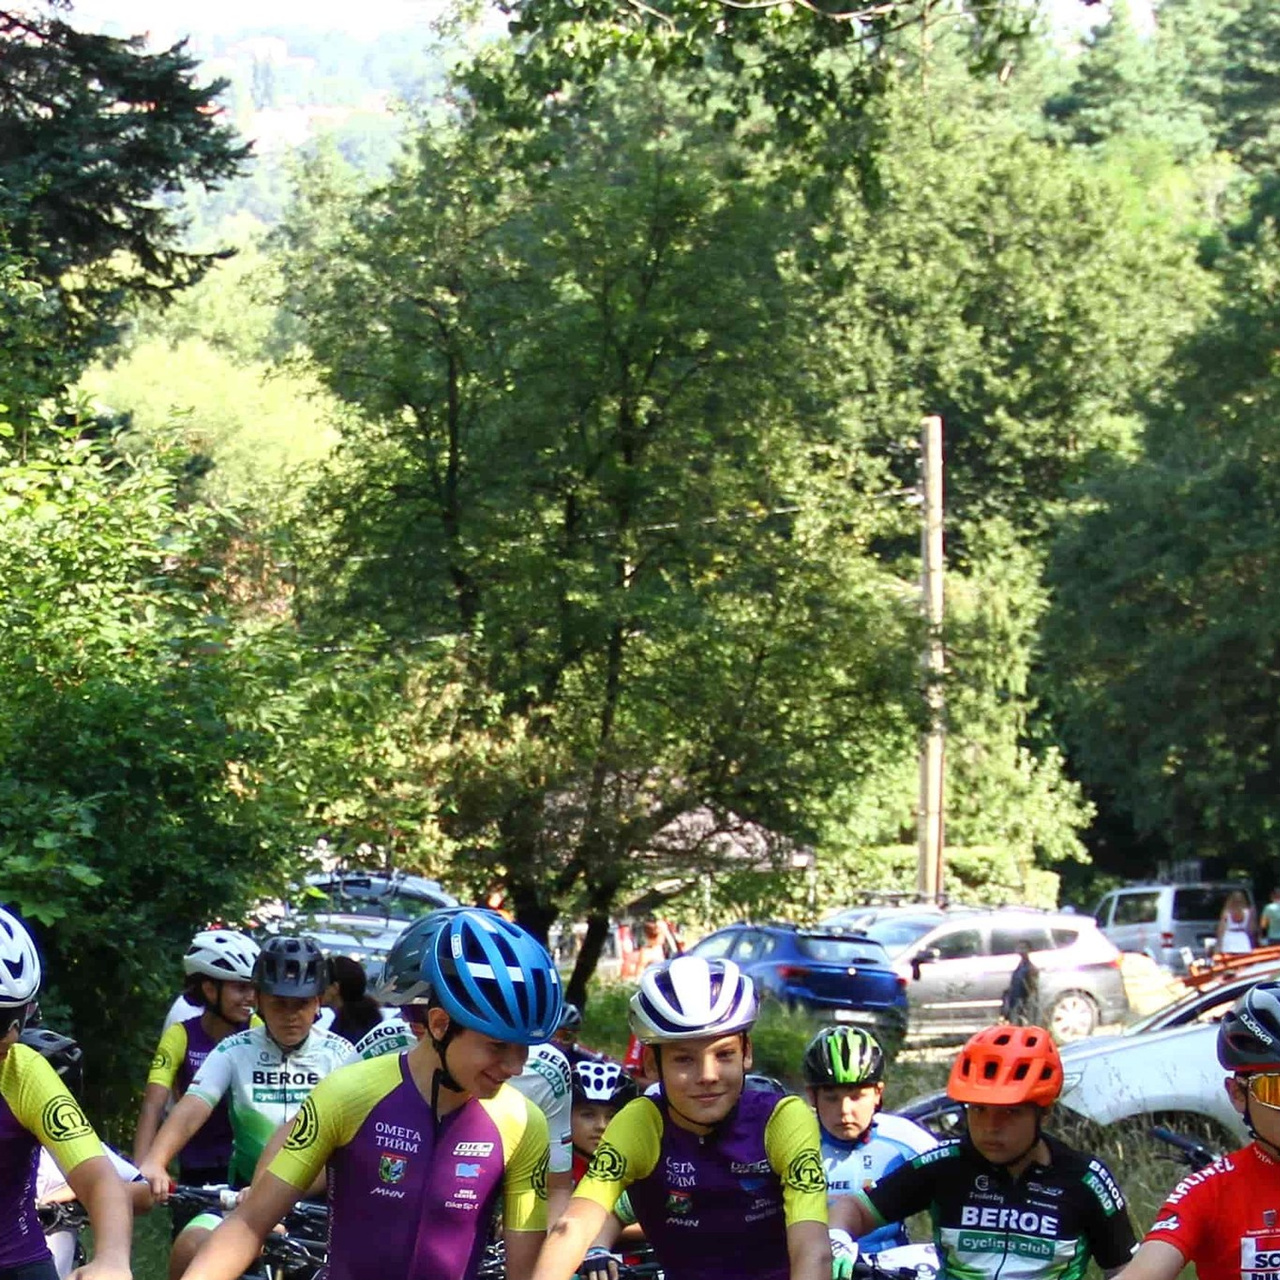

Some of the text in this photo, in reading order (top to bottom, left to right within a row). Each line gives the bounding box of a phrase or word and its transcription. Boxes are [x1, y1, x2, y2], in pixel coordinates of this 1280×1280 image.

[369, 1039, 400, 1058] MTB
[252, 1070, 319, 1086] BEROE
[375, 1121, 422, 1142] ОМЕГА
[375, 1135, 419, 1154] ТИЙМ
[919, 1147, 952, 1164] MTB
[1087, 1159, 1125, 1211] BEROE
[1089, 1174, 1113, 1211] ROAD
[960, 1205, 1059, 1236] BEROE
[961, 1236, 1052, 1257] cycling club
